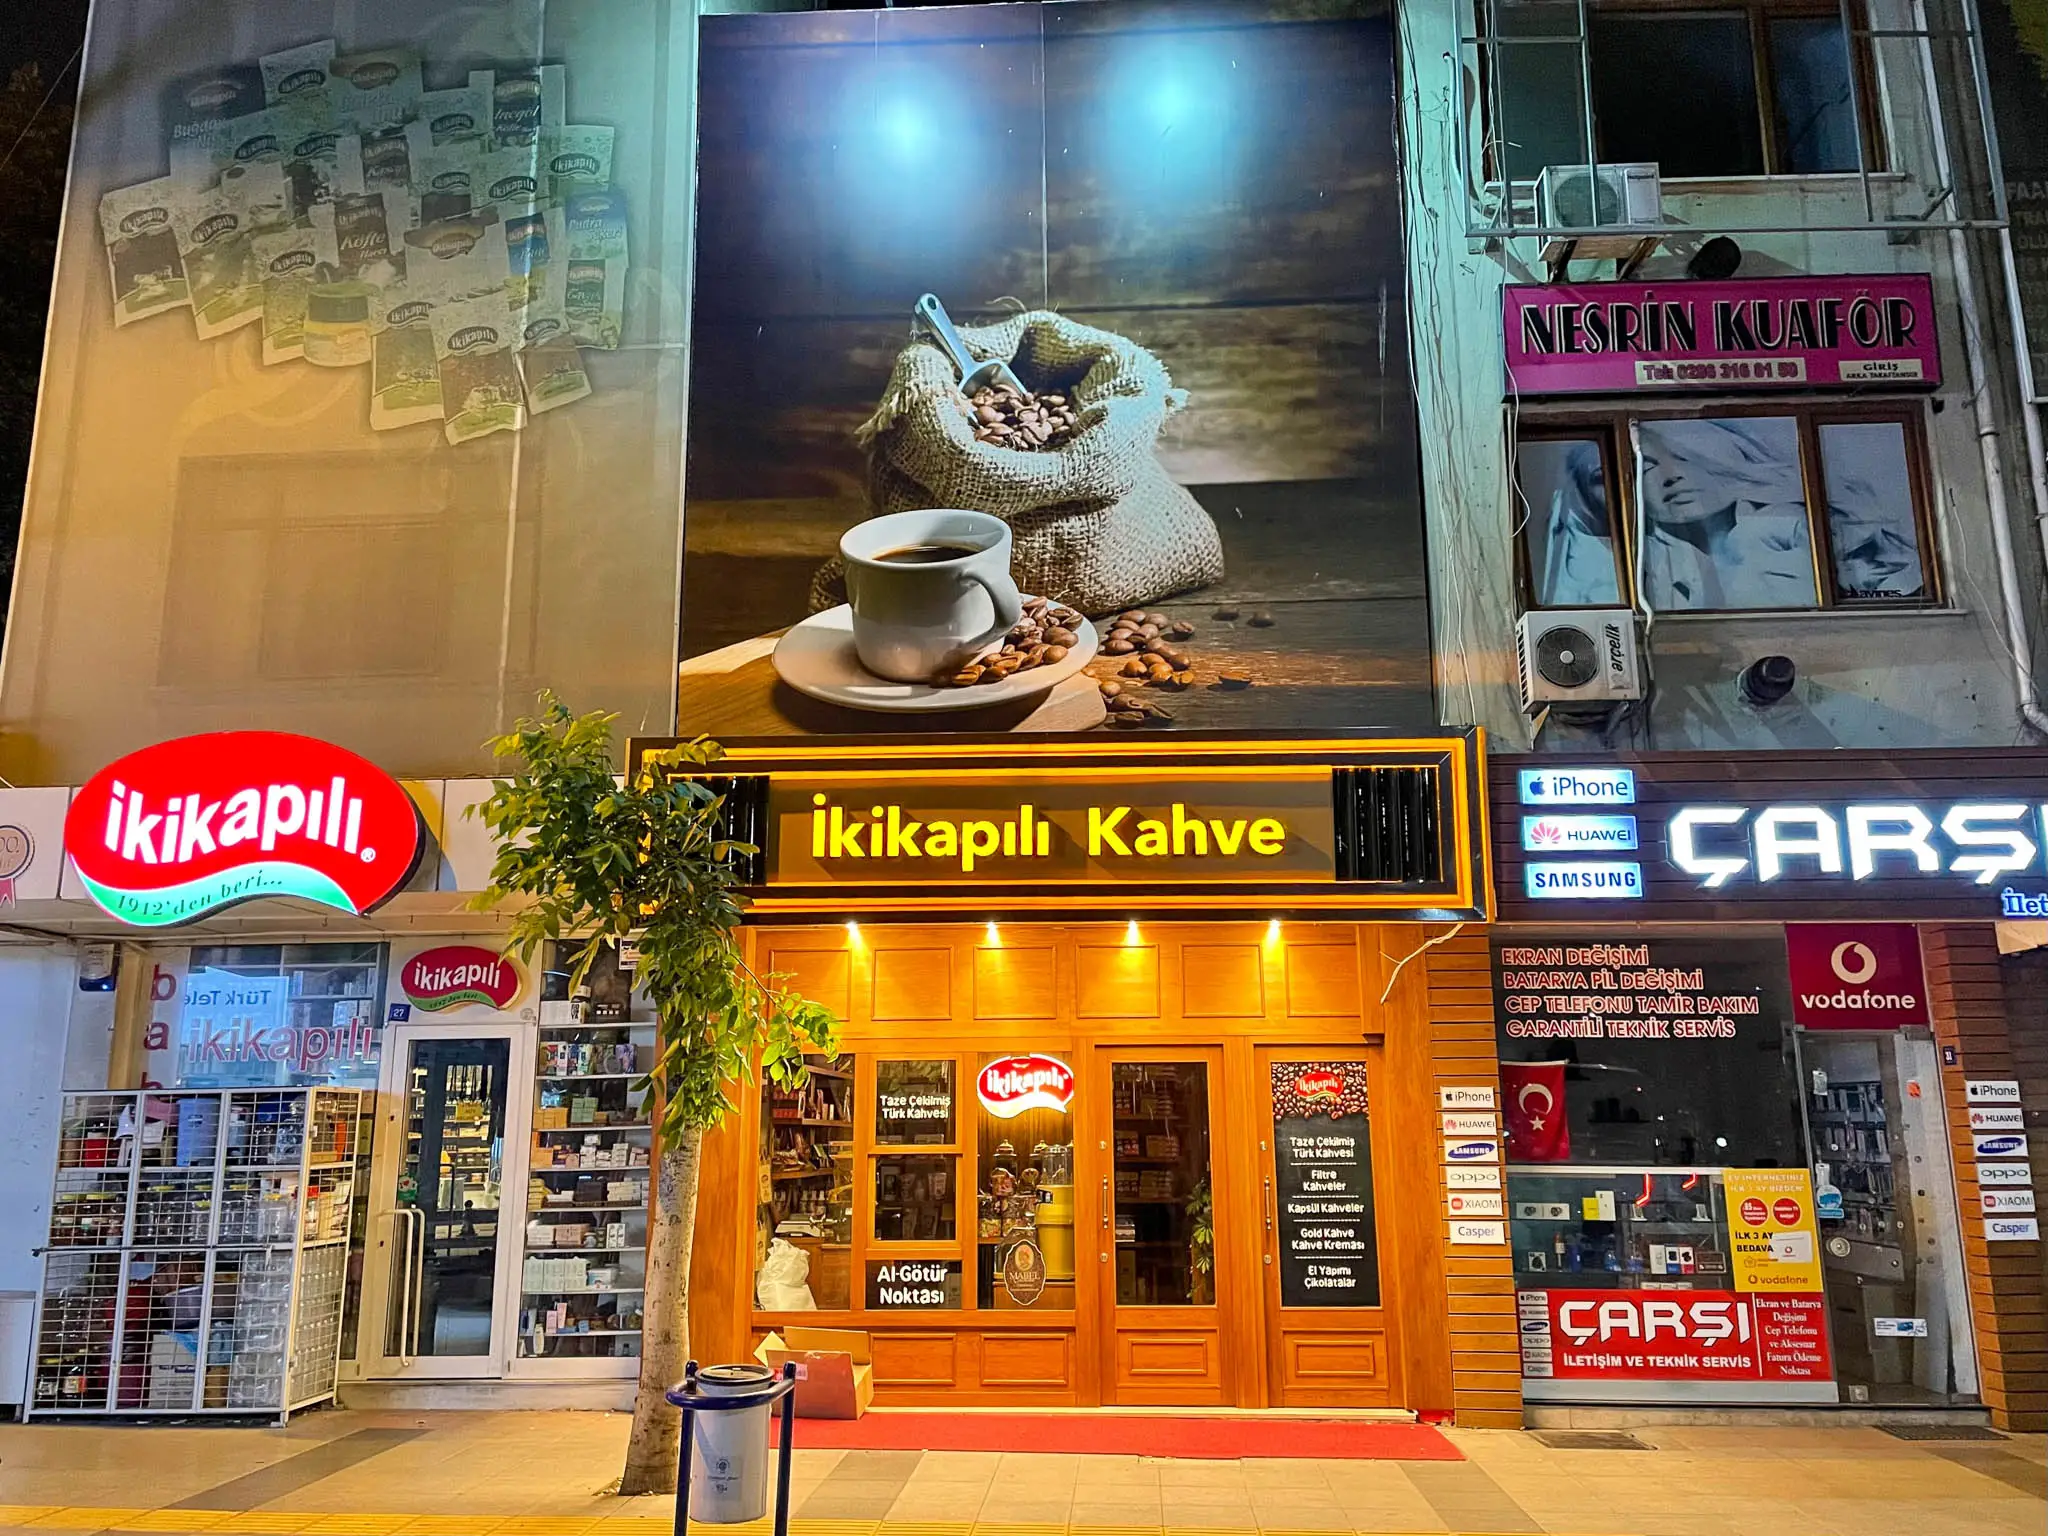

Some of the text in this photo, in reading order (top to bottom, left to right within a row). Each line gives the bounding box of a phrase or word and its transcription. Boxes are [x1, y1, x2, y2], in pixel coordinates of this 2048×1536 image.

[1520, 289, 1917, 354] NESRİN KUAFÖR
[1604, 623, 1624, 672] arçelik
[1553, 776, 1628, 796] iPhone
[813, 793, 1286, 872] İkikapılı Kahve
[1568, 829, 1631, 841] HUAWEI
[1668, 804, 2048, 888] ÇARŞ
[1535, 871, 1636, 888] SAMSUNG
[1501, 945, 1650, 969] EKRAN DEĞİŞİMİ
[1503, 967, 1704, 994] BATARYA PİL DEĞİŞİMİ
[1504, 992, 1759, 1014] CEP TELEFONU TAMİR BAKIM
[1801, 989, 1916, 1010] vodafone
[393, 1008, 404, 1017] 27
[1506, 1016, 1736, 1038] GARANTİLİ TEKNİK SERVİS
[1979, 1084, 2018, 1096] iPhone
[880, 1095, 951, 1109] Taze Çekilmiş
[1454, 1091, 1492, 1102] iPhone
[882, 1108, 949, 1119] Türk Kahvesi
[1986, 1114, 2022, 1122] HUAWEI
[1458, 1120, 1495, 1128] HUAWEI
[1289, 1137, 1355, 1148] Taze Çekilmiş
[1293, 1148, 1354, 1158] Türk Kahvesi
[1311, 1169, 1337, 1180] Filtre
[1450, 1173, 1497, 1183] oppo
[1981, 1169, 2029, 1179] oppo
[1303, 1181, 1346, 1191] Kahveler
[1464, 1199, 1500, 1209] XIAOMI
[1997, 1197, 2033, 1206] XIAOMI
[1288, 1203, 1364, 1214] Kapsül Kahveler
[1300, 1228, 1354, 1238] Gold Kahve
[1458, 1226, 1496, 1239] Casper
[1992, 1223, 2030, 1236] Casper
[1292, 1240, 1364, 1250] Kahve Kreması
[1737, 1244, 1775, 1252] BEDAVA
[877, 1265, 948, 1283] Al-Götür
[1308, 1265, 1351, 1276] El Yapımı
[1304, 1278, 1357, 1290] Çikolatalar
[1760, 1275, 1809, 1285] vodafone
[880, 1287, 944, 1304] Noktası
[1756, 1298, 1779, 1308] Ekran
[1791, 1299, 1822, 1310] Batarya
[1559, 1301, 1750, 1347] ÇARŞI
[1765, 1325, 1818, 1336] Cep Telefonu
[1563, 1352, 1751, 1369] İLETİŞİM VE TEKNİK SERVİS
[1766, 1350, 1822, 1362] Fatura Ödeme
[1780, 1365, 1811, 1375] Noktası
